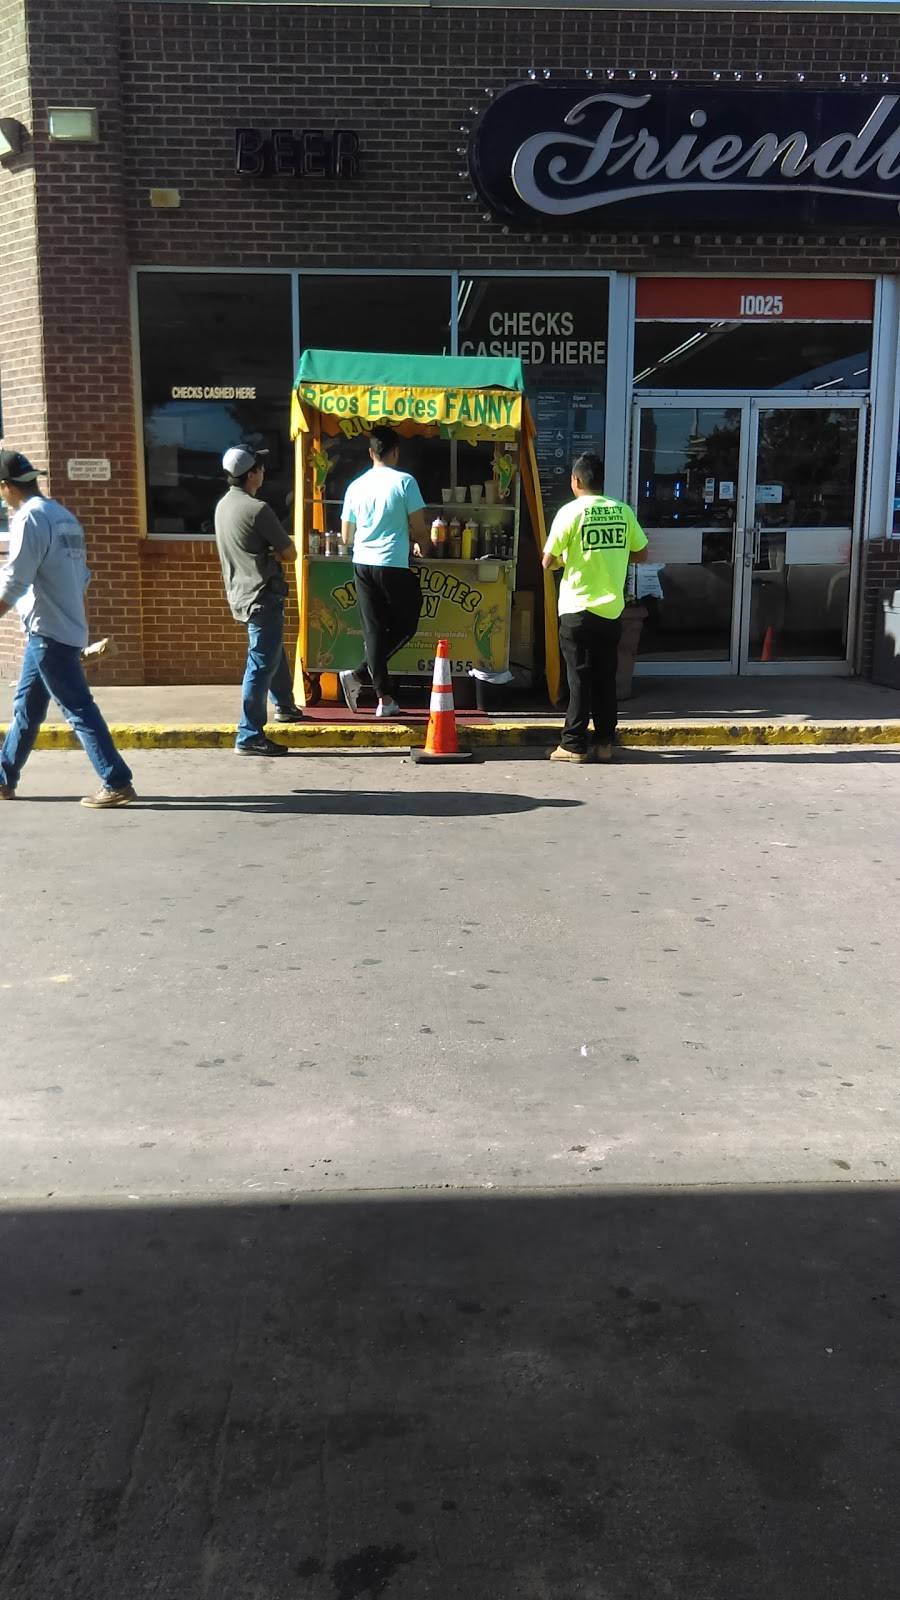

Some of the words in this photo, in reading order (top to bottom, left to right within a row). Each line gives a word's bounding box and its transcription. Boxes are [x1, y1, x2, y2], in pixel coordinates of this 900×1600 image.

[235, 128, 361, 178] BEER
[511, 92, 900, 216] Friendl
[740, 295, 784, 317] 10025
[489, 311, 575, 337] CHECKS
[460, 341, 545, 365] CASHED
[551, 341, 607, 365] HERE
[171, 387, 203, 399] CHECKS
[204, 387, 235, 399] CASHED
[235, 387, 256, 399] HERE
[303, 387, 359, 415] Ricos
[368, 390, 437, 417] ELotes
[445, 391, 515, 425] FANNY
[584, 506, 623, 516] SAFETY
[586, 528, 624, 545] ONE
[410, 566, 483, 613] LOTES
